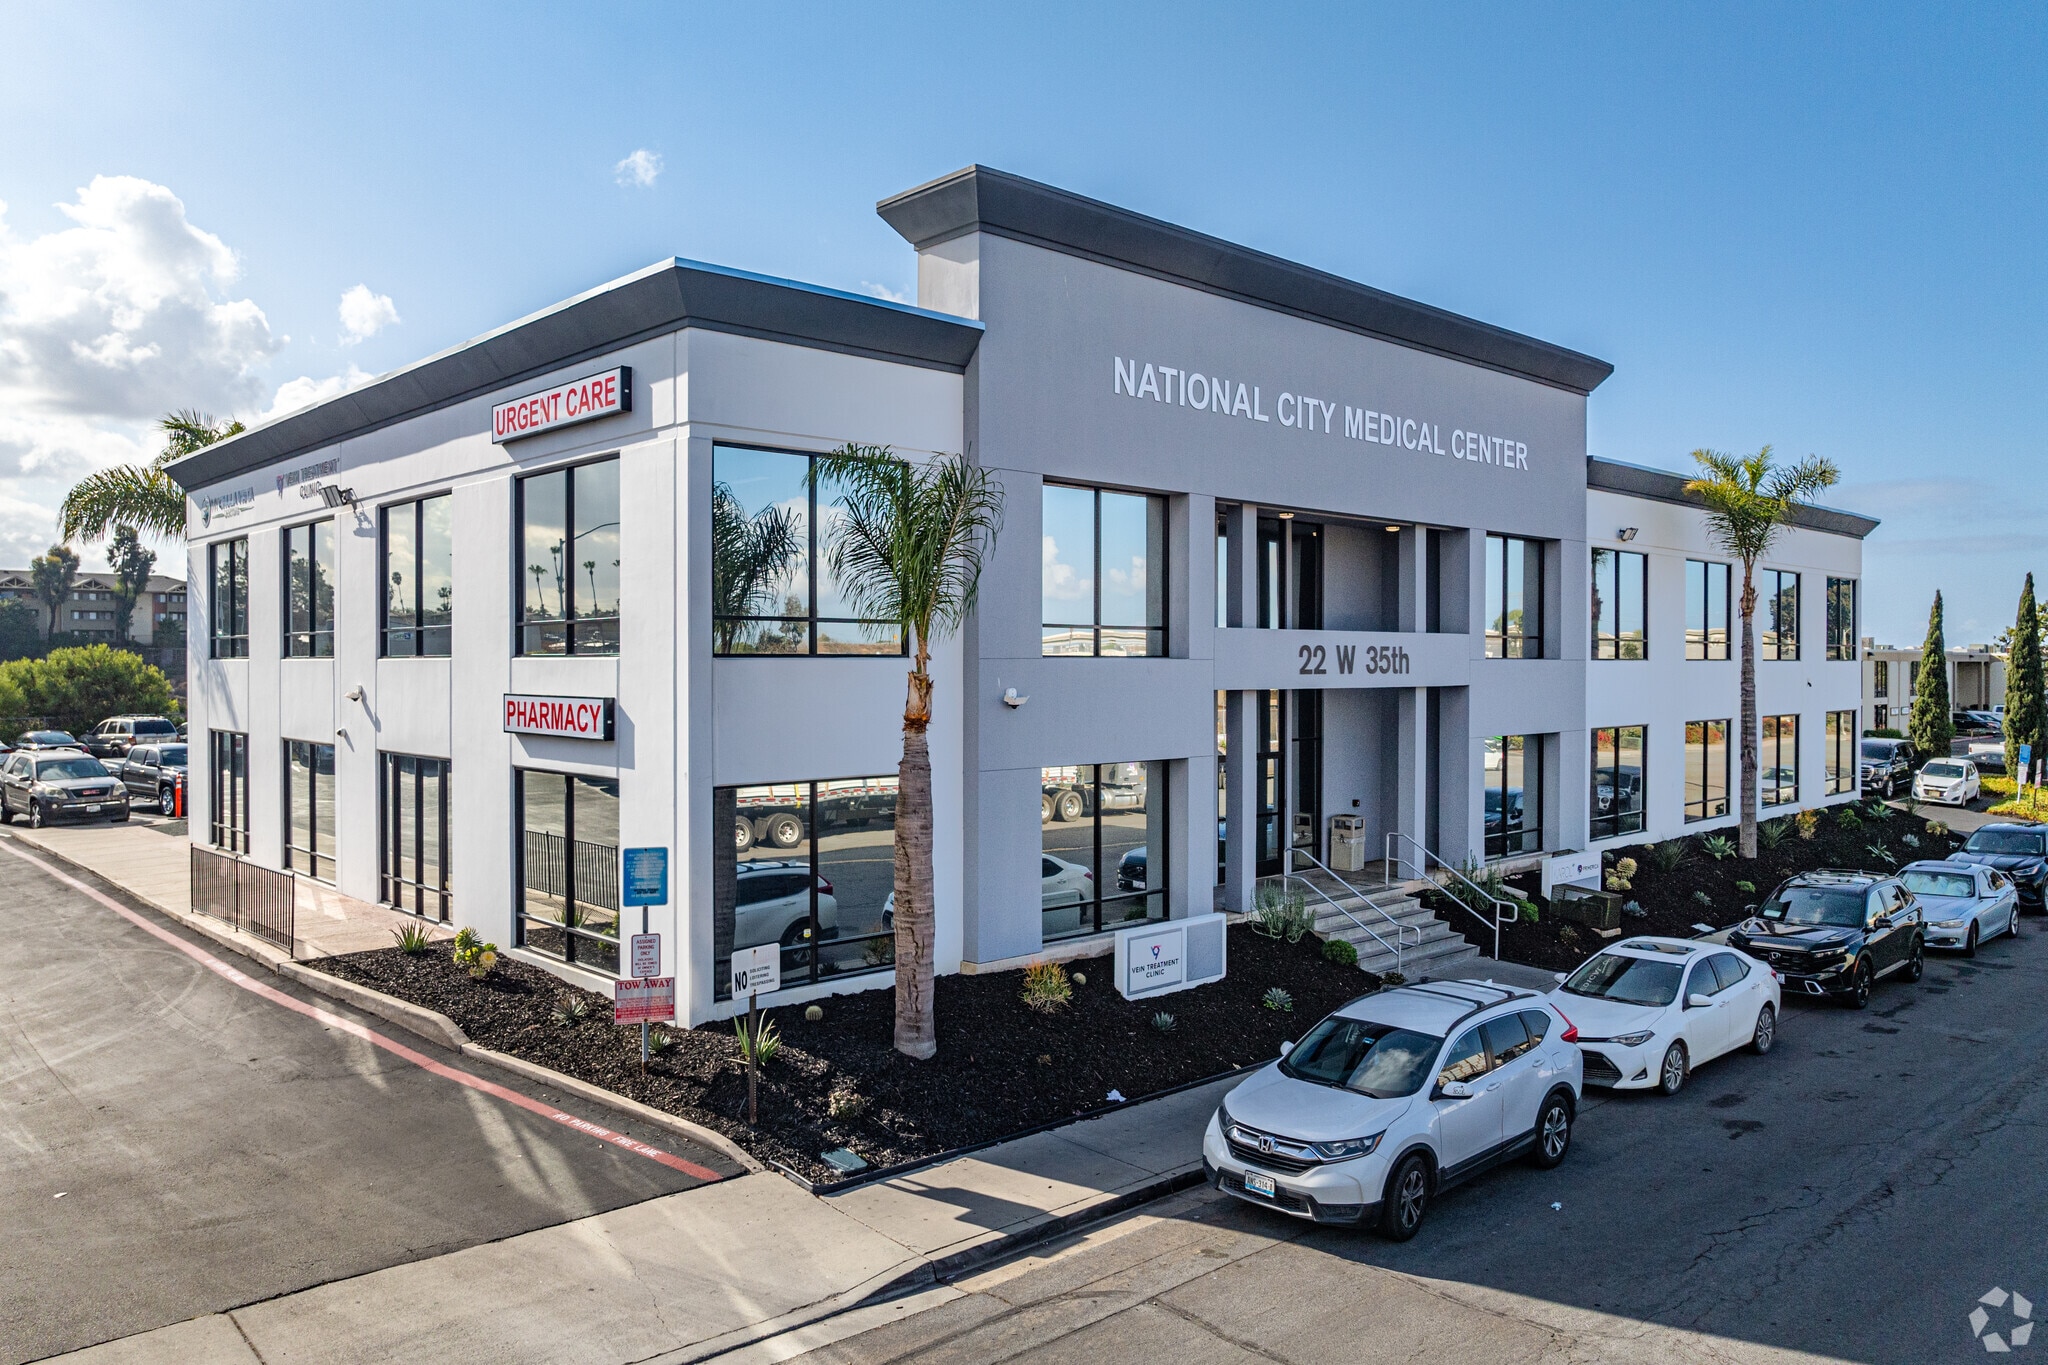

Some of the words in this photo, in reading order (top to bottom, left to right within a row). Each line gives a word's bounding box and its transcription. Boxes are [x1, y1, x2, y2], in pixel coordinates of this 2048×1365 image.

[496, 392, 561, 436] URGENT
[566, 376, 616, 417] CARE
[1114, 356, 1269, 422] NATIONAL
[1277, 392, 1336, 434] CITY
[1344, 406, 1446, 456] MEDICAL
[1450, 429, 1529, 471] CENTER
[1299, 645, 1327, 675] 22
[1336, 645, 1356, 674] W
[1365, 645, 1410, 674] 35th
[507, 700, 602, 733] PHARMACY
[750, 965, 770, 973] SOLICITING
[750, 972, 769, 980] LOITERING
[1132, 965, 1145, 973] VEIN
[1147, 958, 1179, 970] TREATMENT
[1146, 969, 1165, 978] CLINIC
[618, 981, 641, 990] TOW
[643, 979, 671, 988] AWAY
[735, 970, 748, 992] NO
[552, 1113, 570, 1121] NO
[569, 1119, 610, 1137] PARKING
[612, 1136, 638, 1147] FIRE
[634, 1144, 662, 1157] LANE
